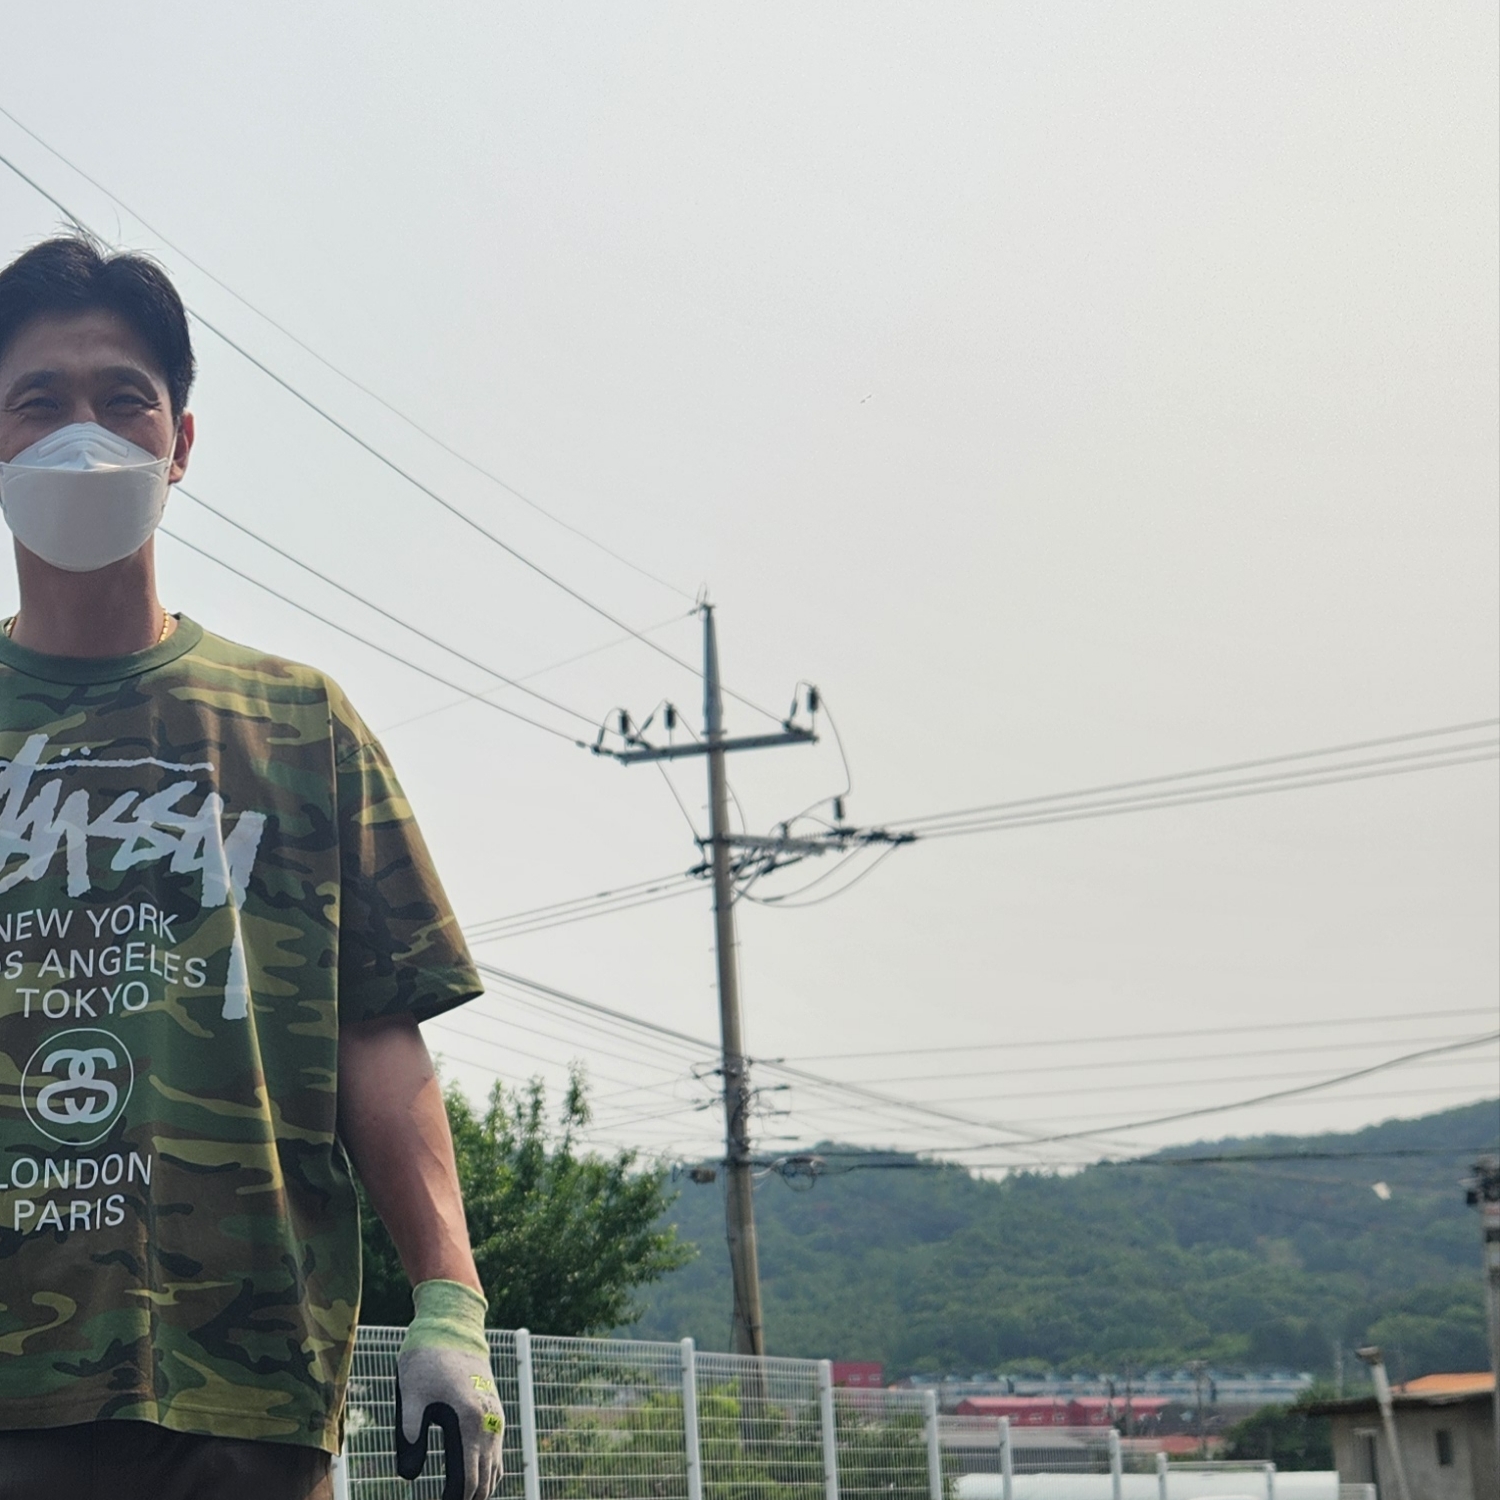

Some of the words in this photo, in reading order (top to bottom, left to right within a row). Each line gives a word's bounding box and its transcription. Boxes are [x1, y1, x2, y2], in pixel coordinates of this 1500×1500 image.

[85, 902, 179, 944] YORK
[37, 942, 207, 988] ANGELES
[15, 980, 150, 1019] TOKYO
[13, 1194, 126, 1232] PARIS
